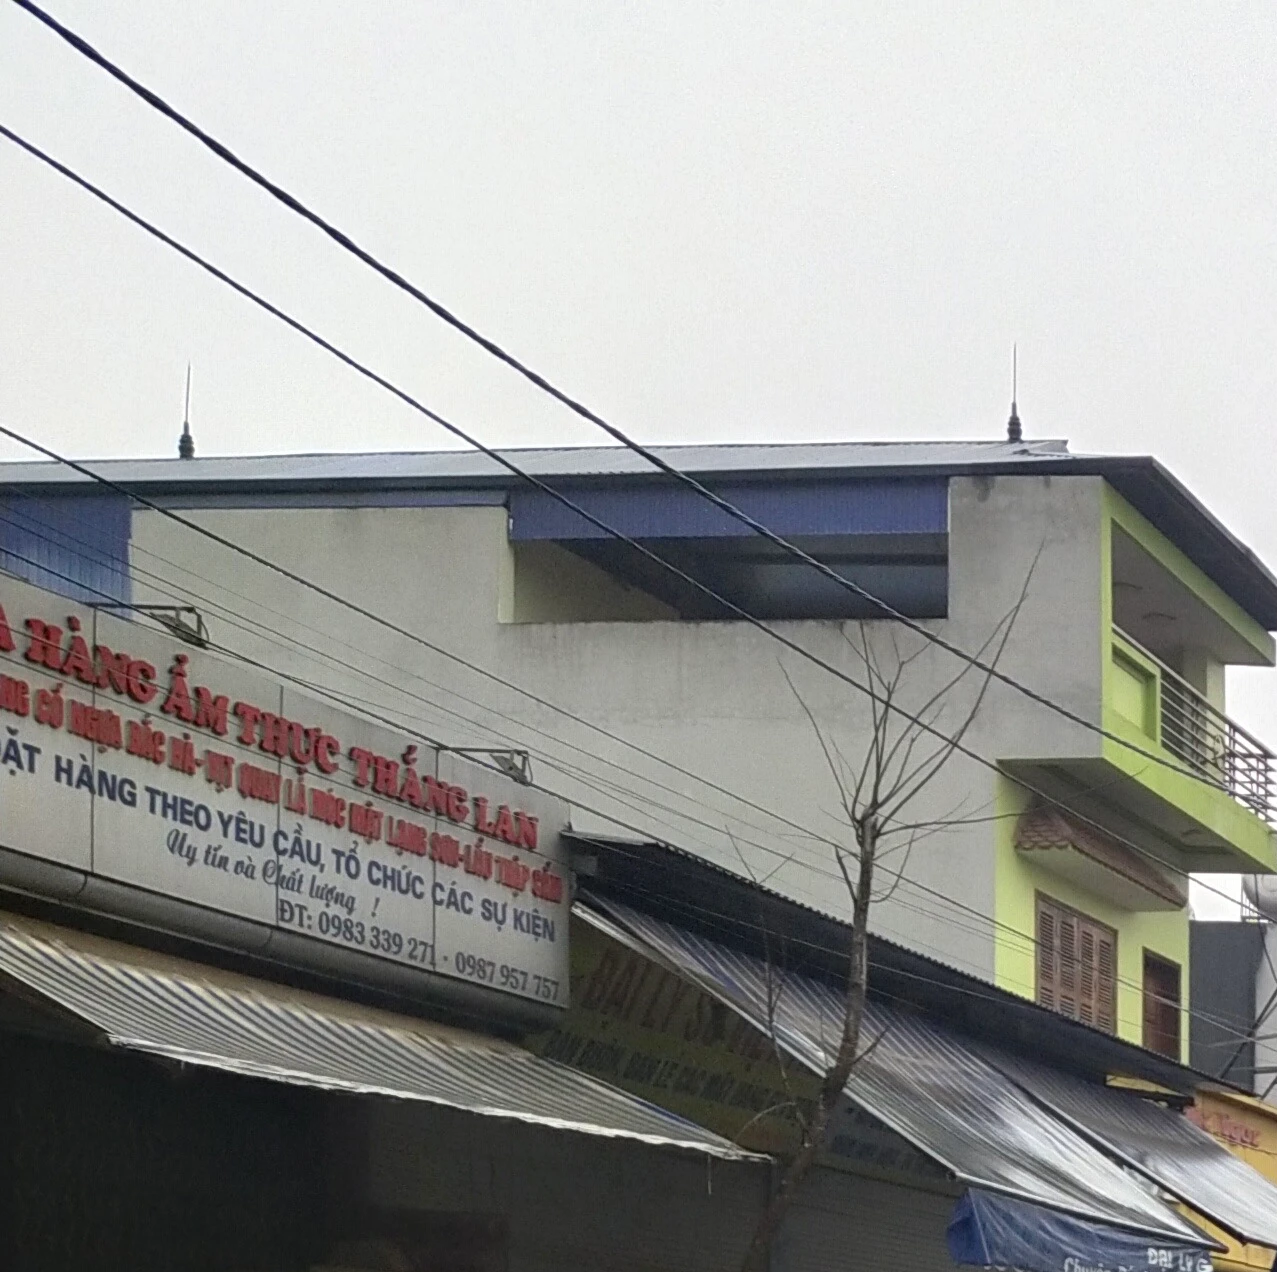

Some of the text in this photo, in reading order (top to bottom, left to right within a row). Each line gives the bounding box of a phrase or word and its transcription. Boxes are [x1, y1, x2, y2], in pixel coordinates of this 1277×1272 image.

[24, 616, 158, 704] HÀNG
[160, 653, 230, 736] ẨM
[233, 701, 341, 776] THỰC
[472, 796, 539, 850] LAN
[0, 726, 42, 776] ẶT
[54, 753, 138, 808] HÀNG
[144, 785, 213, 832] THEO
[216, 810, 266, 849] YÊU
[331, 840, 361, 880] TỔ
[367, 860, 425, 900] CHỨC
[431, 880, 474, 915] CÁC
[480, 898, 508, 932] SỰ
[513, 908, 556, 942] KIỆN
[166, 828, 198, 867] Uy
[203, 844, 231, 873] tín
[234, 855, 257, 881] và
[278, 898, 313, 930] ĐT:
[318, 911, 366, 945] 0983
[369, 925, 403, 955] 339
[407, 937, 436, 966] 271
[455, 951, 496, 983] 0987
[500, 964, 529, 991] 957
